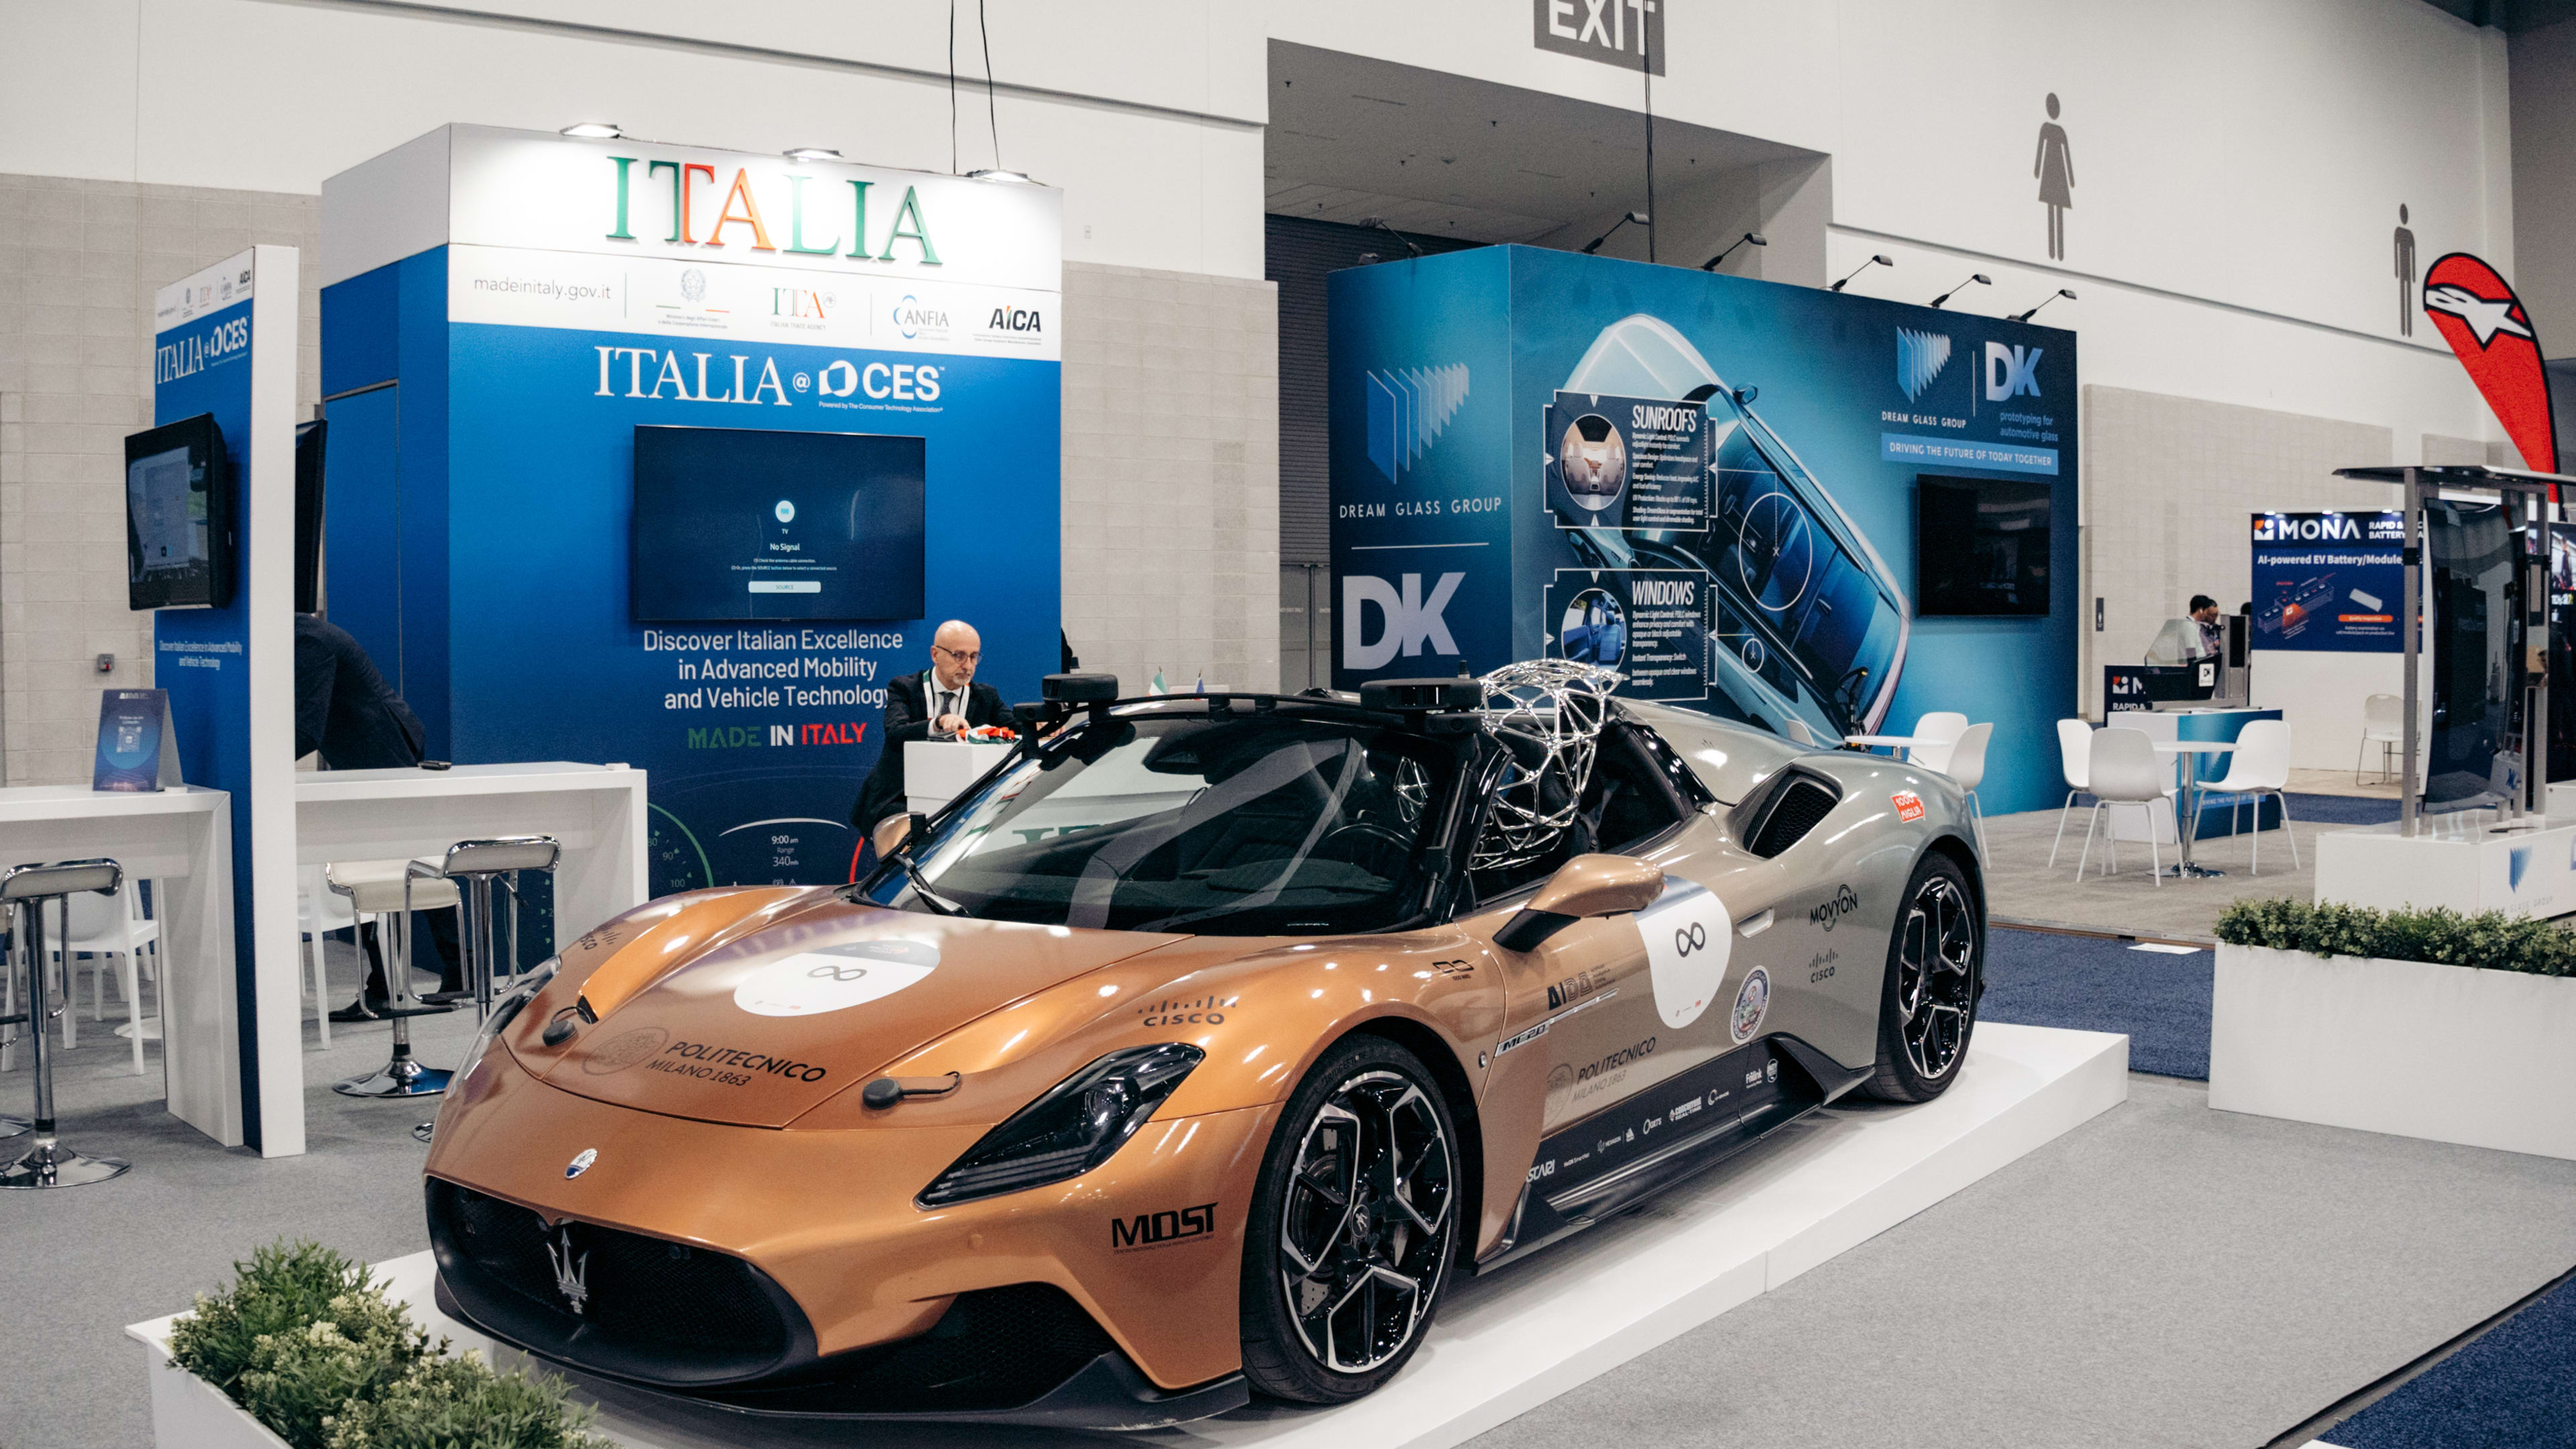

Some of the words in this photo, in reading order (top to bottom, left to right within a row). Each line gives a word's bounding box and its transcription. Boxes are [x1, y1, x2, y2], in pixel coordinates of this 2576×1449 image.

[1549, 0, 1655, 56] EXIT
[606, 156, 943, 265] ITALIA
[474, 276, 611, 301] madeinitaly.gov.it
[771, 287, 826, 319] ITA
[905, 311, 950, 327] ANFIA
[157, 334, 204, 384] ITALIA
[223, 316, 248, 353] CES
[594, 346, 792, 406] ITALIA
[792, 372, 810, 392] @
[862, 362, 941, 401] CES
[1986, 341, 2043, 402] DK
[1631, 405, 1697, 432] SUNROOFS
[1882, 411, 1909, 422] DREAM
[1913, 414, 1937, 426] GLASS
[1941, 417, 1966, 429] GROUP
[2000, 411, 2041, 427] prototyping
[2043, 416, 2053, 425] for
[2000, 427, 2039, 439] automotive
[2041, 431, 2059, 443] glass
[1889, 441, 1925, 455] DRIVING
[1927, 445, 1942, 456] THE
[1944, 447, 1974, 459] FUTURE
[1976, 450, 1987, 460] OF
[1988, 451, 2013, 462] TODAY
[2014, 453, 2052, 466] TOGETHER
[1340, 503, 1385, 518] DREAM
[1396, 500, 1441, 515] GLASS
[1451, 497, 1502, 513] GROUP
[2279, 519, 2361, 539] MONA
[2369, 521, 2395, 529] RAPID
[2396, 521, 2404, 529] &
[770, 543, 780, 551] No
[780, 543, 800, 552] Signal
[2257, 555, 2312, 566] AI-powered
[2314, 555, 2325, 565] EV
[1632, 581, 1695, 605] WINDOWS
[1342, 572, 1466, 669] DK
[644, 630, 734, 652] Discover
[737, 629, 797, 650] Italian
[801, 629, 903, 649] Excellence
[679, 659, 696, 680] in
[701, 658, 800, 679] Advanced
[804, 657, 877, 681] Mobility
[664, 689, 702, 710] and
[707, 686, 779, 707] Vehicle
[688, 726, 761, 749] MADE
[769, 724, 794, 746] IN
[802, 722, 867, 745] ITALY
[772, 835, 789, 844] 9:00
[671, 879, 685, 888] 100
[1810, 894, 1858, 926] MOVYON
[1547, 971, 1594, 1010] AIDA
[646, 1059, 712, 1080] MILANO
[709, 1067, 751, 1086] 1863
[666, 1040, 826, 1082] POLITECNICO
[1576, 1036, 1656, 1085] POLITECNICO
[1572, 1082, 1607, 1104] MILANO
[1112, 1202, 1218, 1248] MOST
